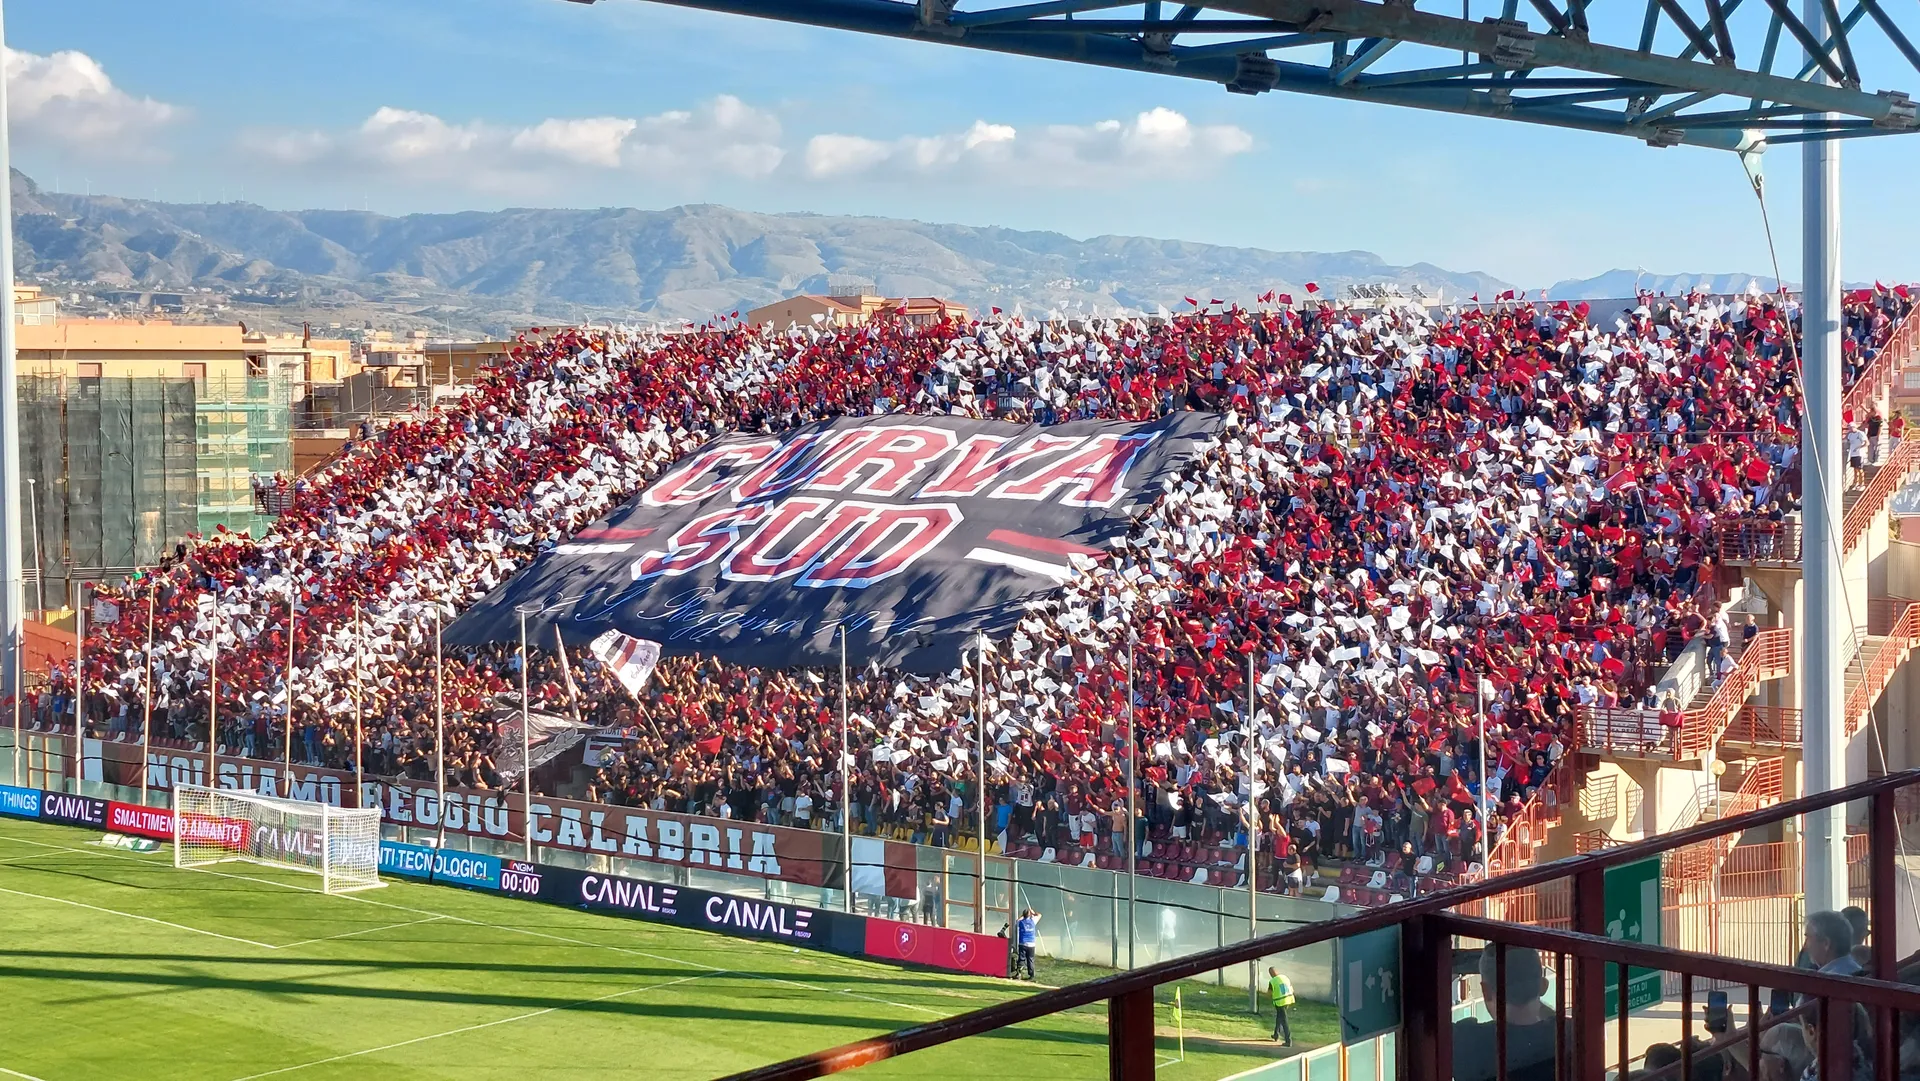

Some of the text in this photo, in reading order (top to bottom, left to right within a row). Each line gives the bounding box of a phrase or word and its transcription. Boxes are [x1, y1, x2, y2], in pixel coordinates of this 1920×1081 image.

[642, 425, 1164, 508] CURVA
[630, 498, 965, 588] SUD
[2, 791, 37, 811] THINGS
[44, 794, 104, 822] CANALE
[147, 753, 782, 875] NOI SIAMO REGGIO CALABRIA
[189, 820, 242, 843] AMIANTO
[398, 849, 488, 881] TECNOLOGICI
[501, 872, 540, 895] 00:00
[581, 875, 678, 913] CANALE
[705, 896, 813, 936] CANALE
